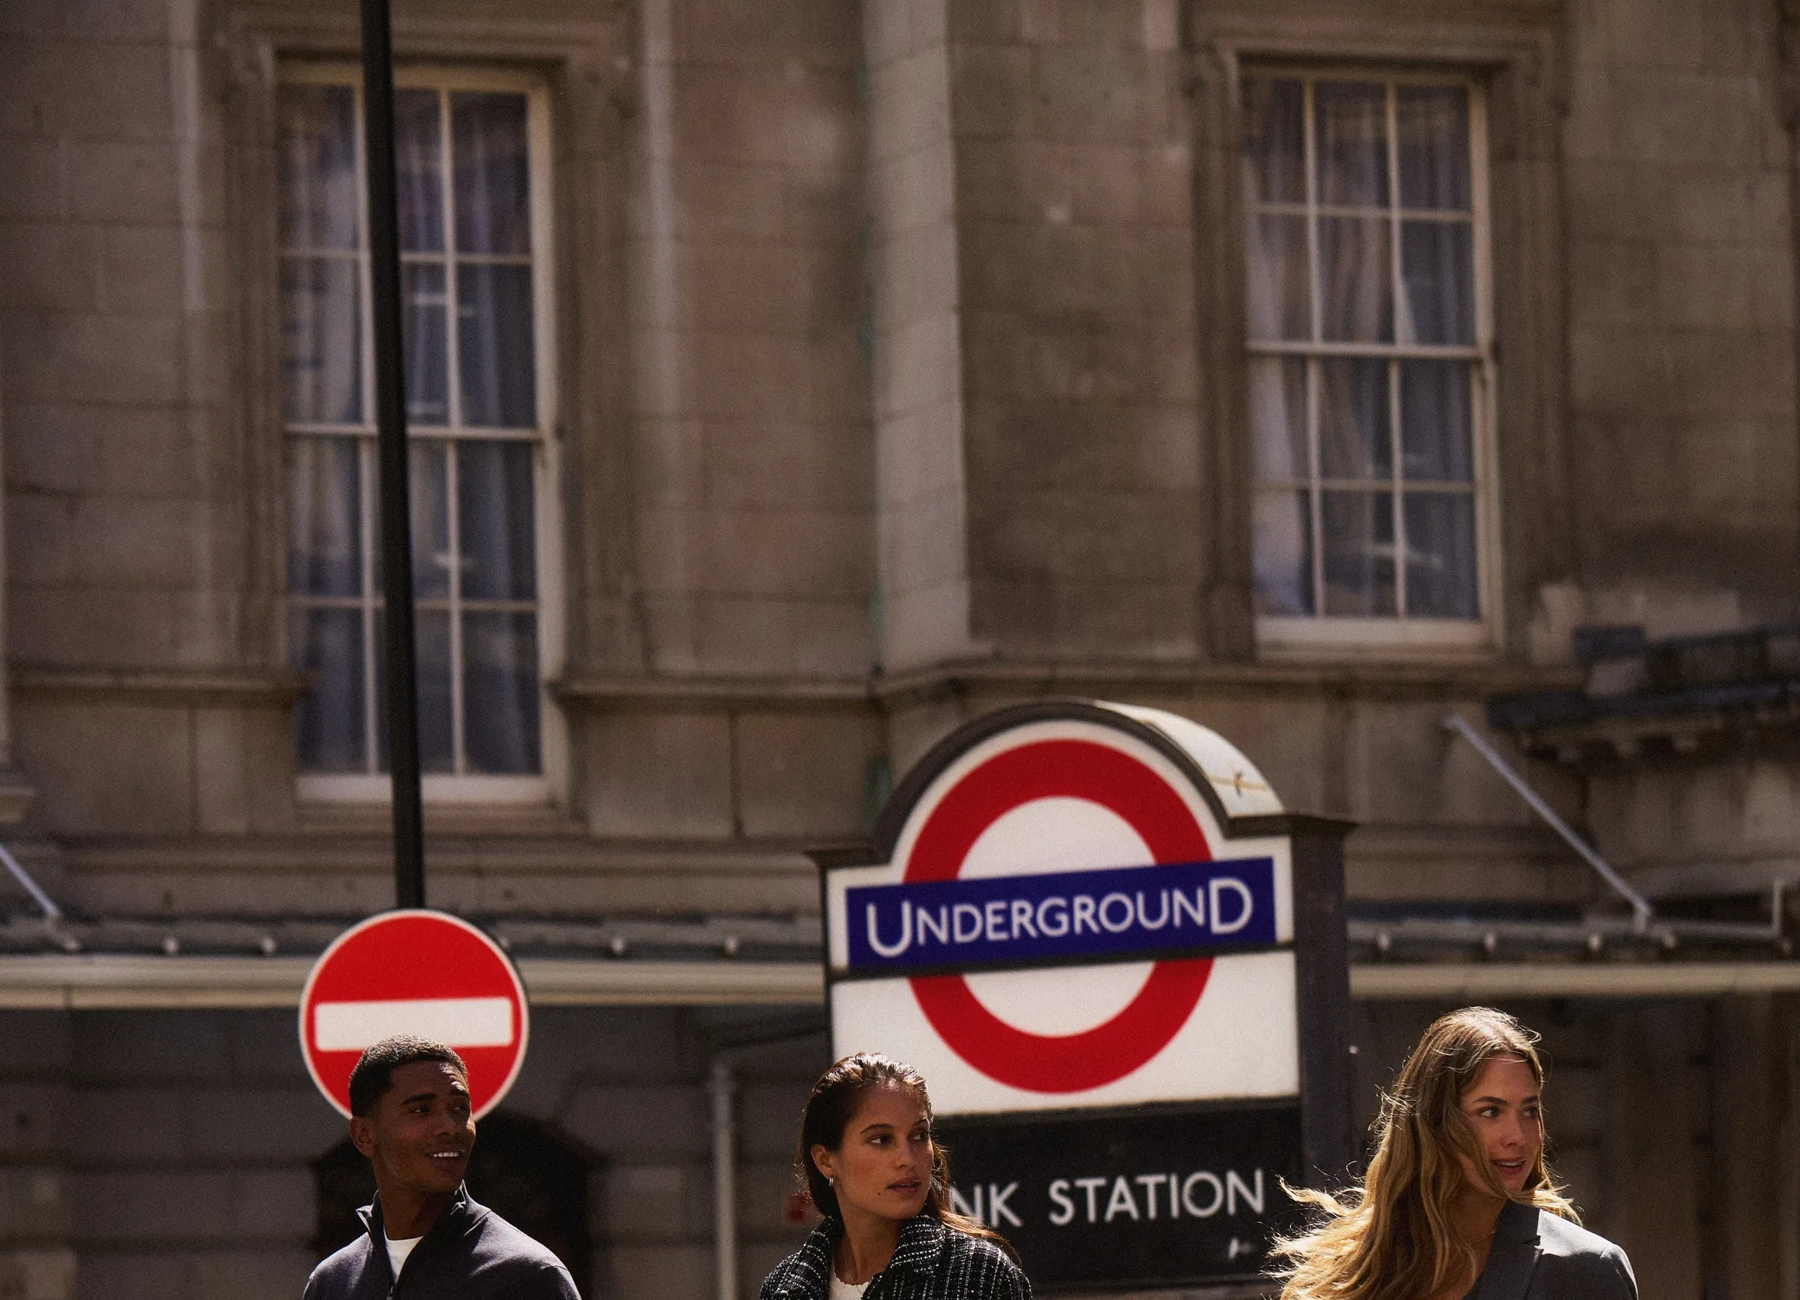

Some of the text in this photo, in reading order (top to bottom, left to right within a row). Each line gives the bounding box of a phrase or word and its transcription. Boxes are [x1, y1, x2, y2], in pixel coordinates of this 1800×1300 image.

[866, 878, 1253, 957] UNDERGROUND
[949, 1168, 1264, 1227] NK STATION
